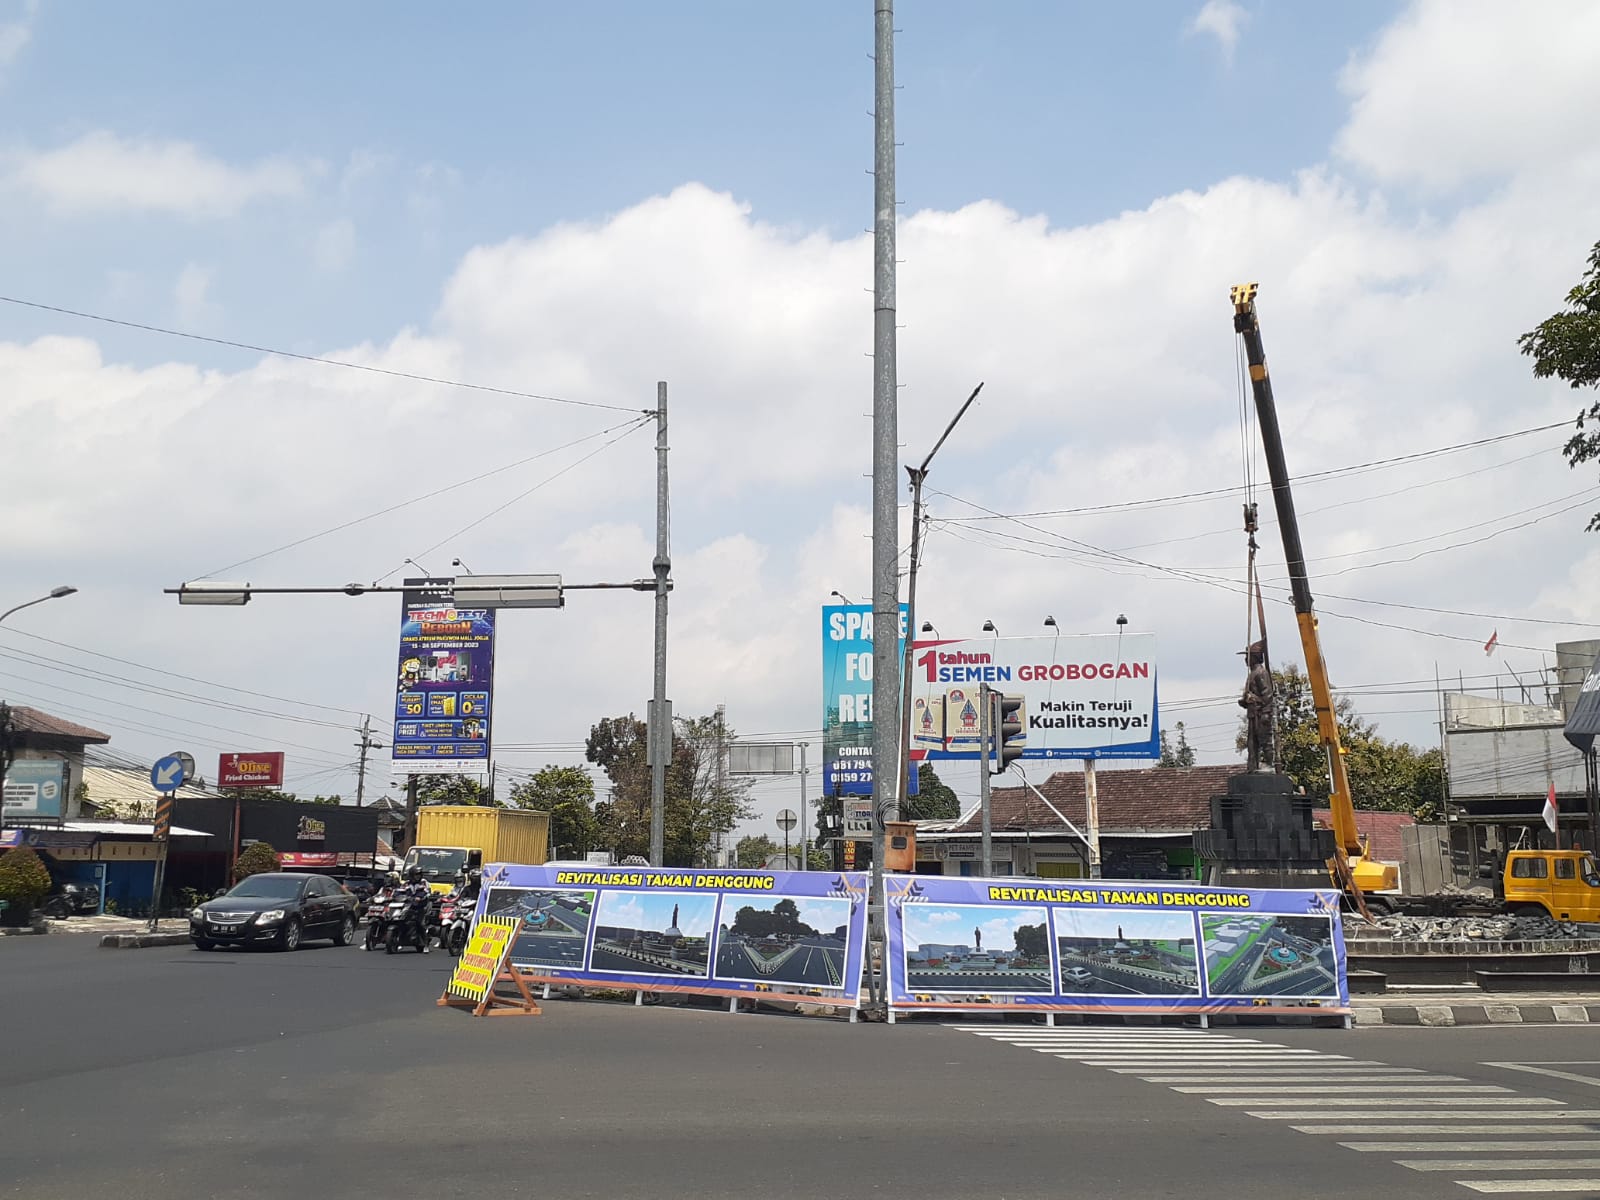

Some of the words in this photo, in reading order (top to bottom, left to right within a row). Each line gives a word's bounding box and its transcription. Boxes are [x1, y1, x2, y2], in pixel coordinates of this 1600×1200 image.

[408, 609, 487, 621] TECHNOFEST
[421, 621, 472, 634] REBORN
[829, 611, 908, 641] SPAE
[845, 652, 873, 681] FO
[917, 650, 937, 683] 1
[938, 651, 991, 664] tahun
[938, 666, 1011, 682] SEMEN
[1018, 662, 1149, 681] GROBOGAN
[839, 693, 873, 722] RE
[1040, 701, 1085, 712] Makin
[1089, 700, 1132, 712] Teruji
[1029, 714, 1148, 730] Kualitasnya!
[839, 747, 873, 756] CONTA
[239, 762, 271, 773] Olive
[859, 773, 873, 781] 27
[556, 872, 642, 886] REVITALISASI
[646, 875, 692, 887] TAMAN
[695, 877, 775, 889] DENGGUNG
[988, 887, 1097, 903] REVITALISASI
[1100, 892, 1158, 905] TAMAN
[1162, 893, 1251, 907] DENGGUNG
